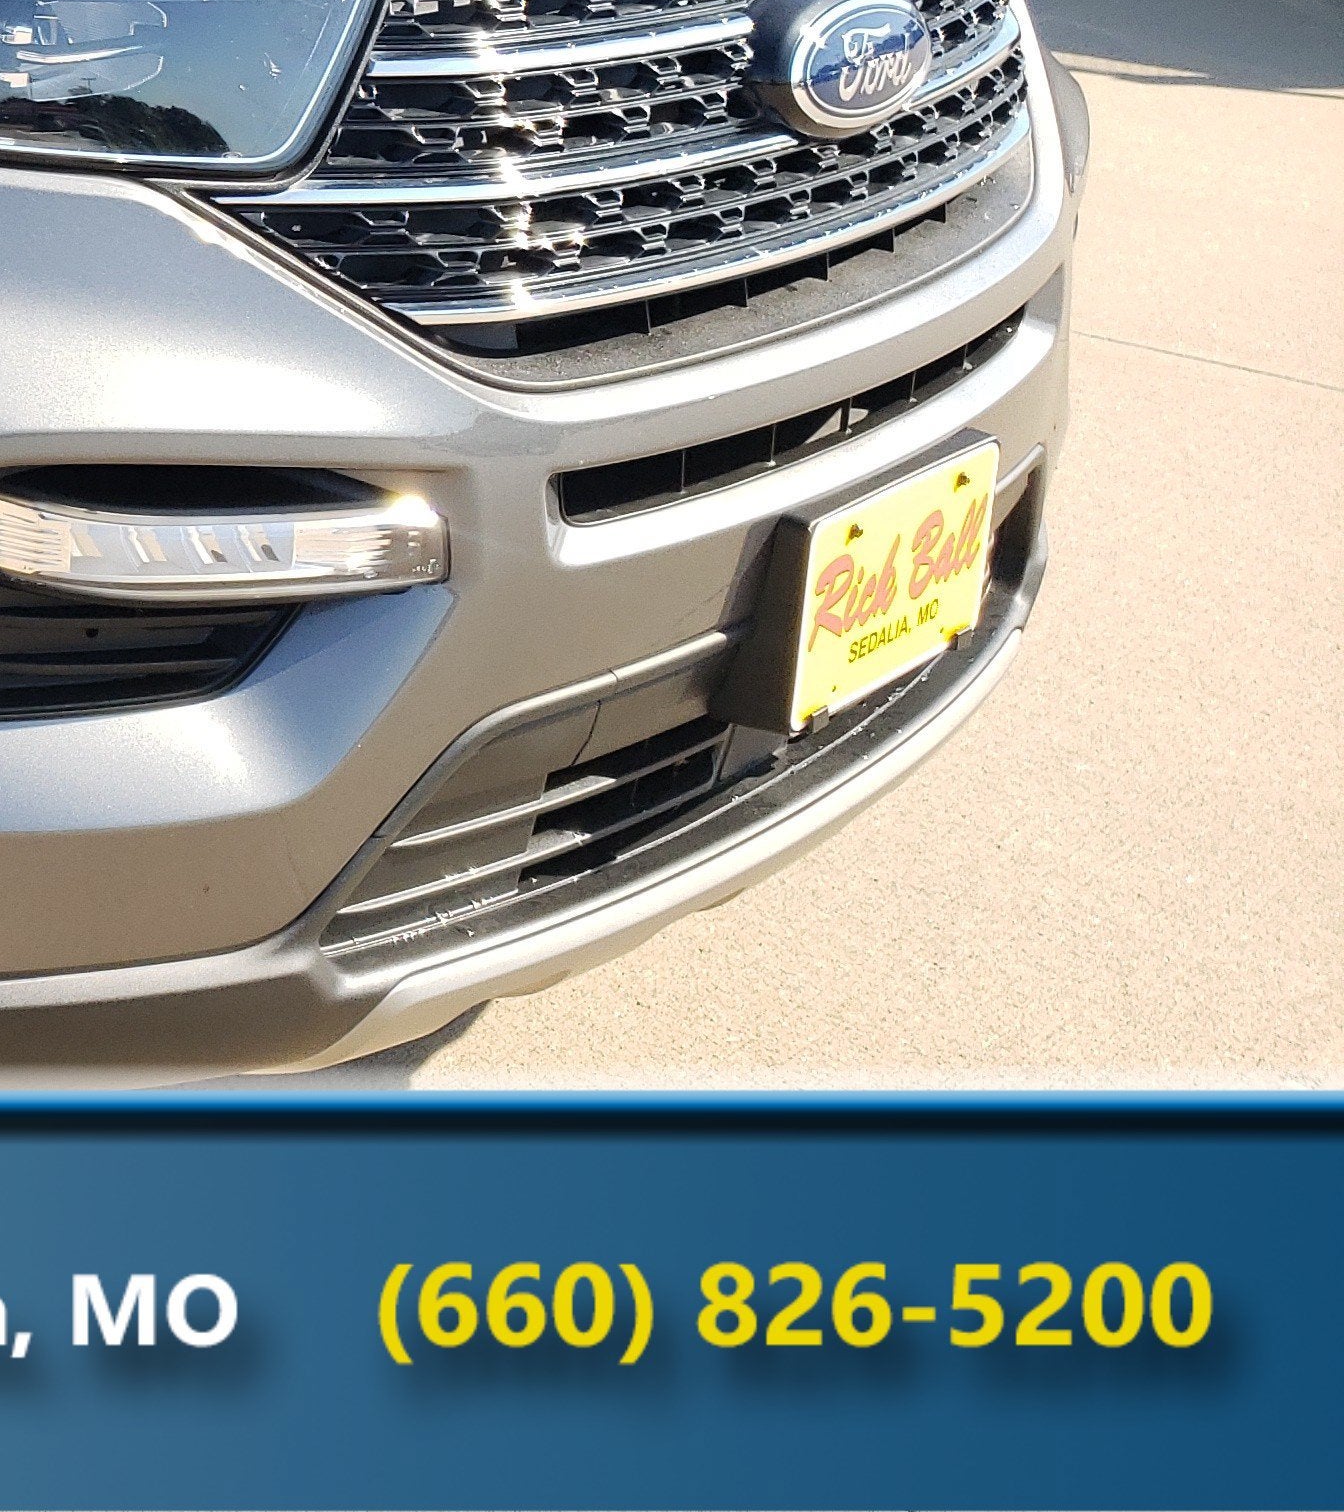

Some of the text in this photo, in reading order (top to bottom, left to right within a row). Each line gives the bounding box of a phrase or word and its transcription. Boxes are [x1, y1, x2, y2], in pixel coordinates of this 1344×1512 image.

[838, 22, 912, 101] Ford
[807, 492, 988, 652] Rick Ball
[917, 598, 939, 627] MO
